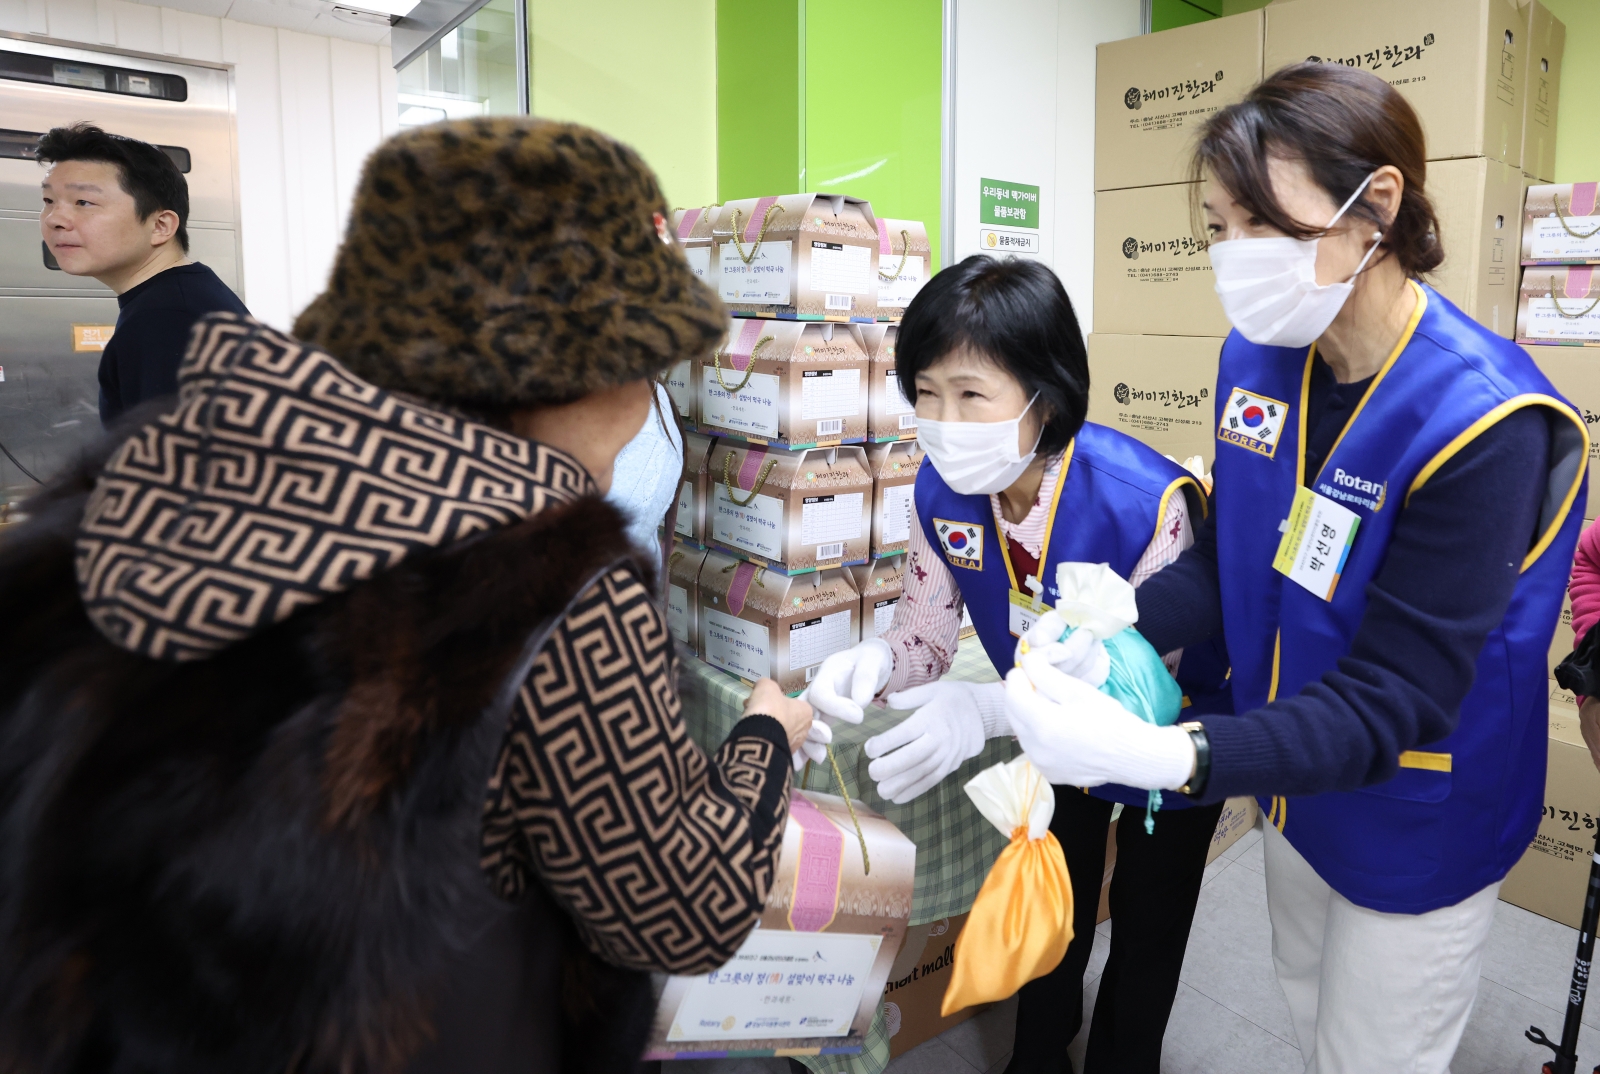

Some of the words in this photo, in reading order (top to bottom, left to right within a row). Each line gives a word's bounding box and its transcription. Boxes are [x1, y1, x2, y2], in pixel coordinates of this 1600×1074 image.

[1142, 80, 1216, 101] 해미진한과
[983, 186, 1010, 200] 우리동네
[994, 205, 1026, 220] 물품보관함
[999, 235, 1031, 248] 물품적재금지
[1140, 237, 1211, 256] 해미진한과
[1131, 388, 1201, 409] 해미진한과
[1222, 429, 1267, 452] KOREA
[947, 553, 976, 568] OREA
[1535, 832, 1555, 843] 산시
[720, 972, 754, 985] 그릇의
[787, 973, 815, 986] 설맞이
[818, 973, 835, 986] 떡국
[837, 973, 855, 986] 나눔
